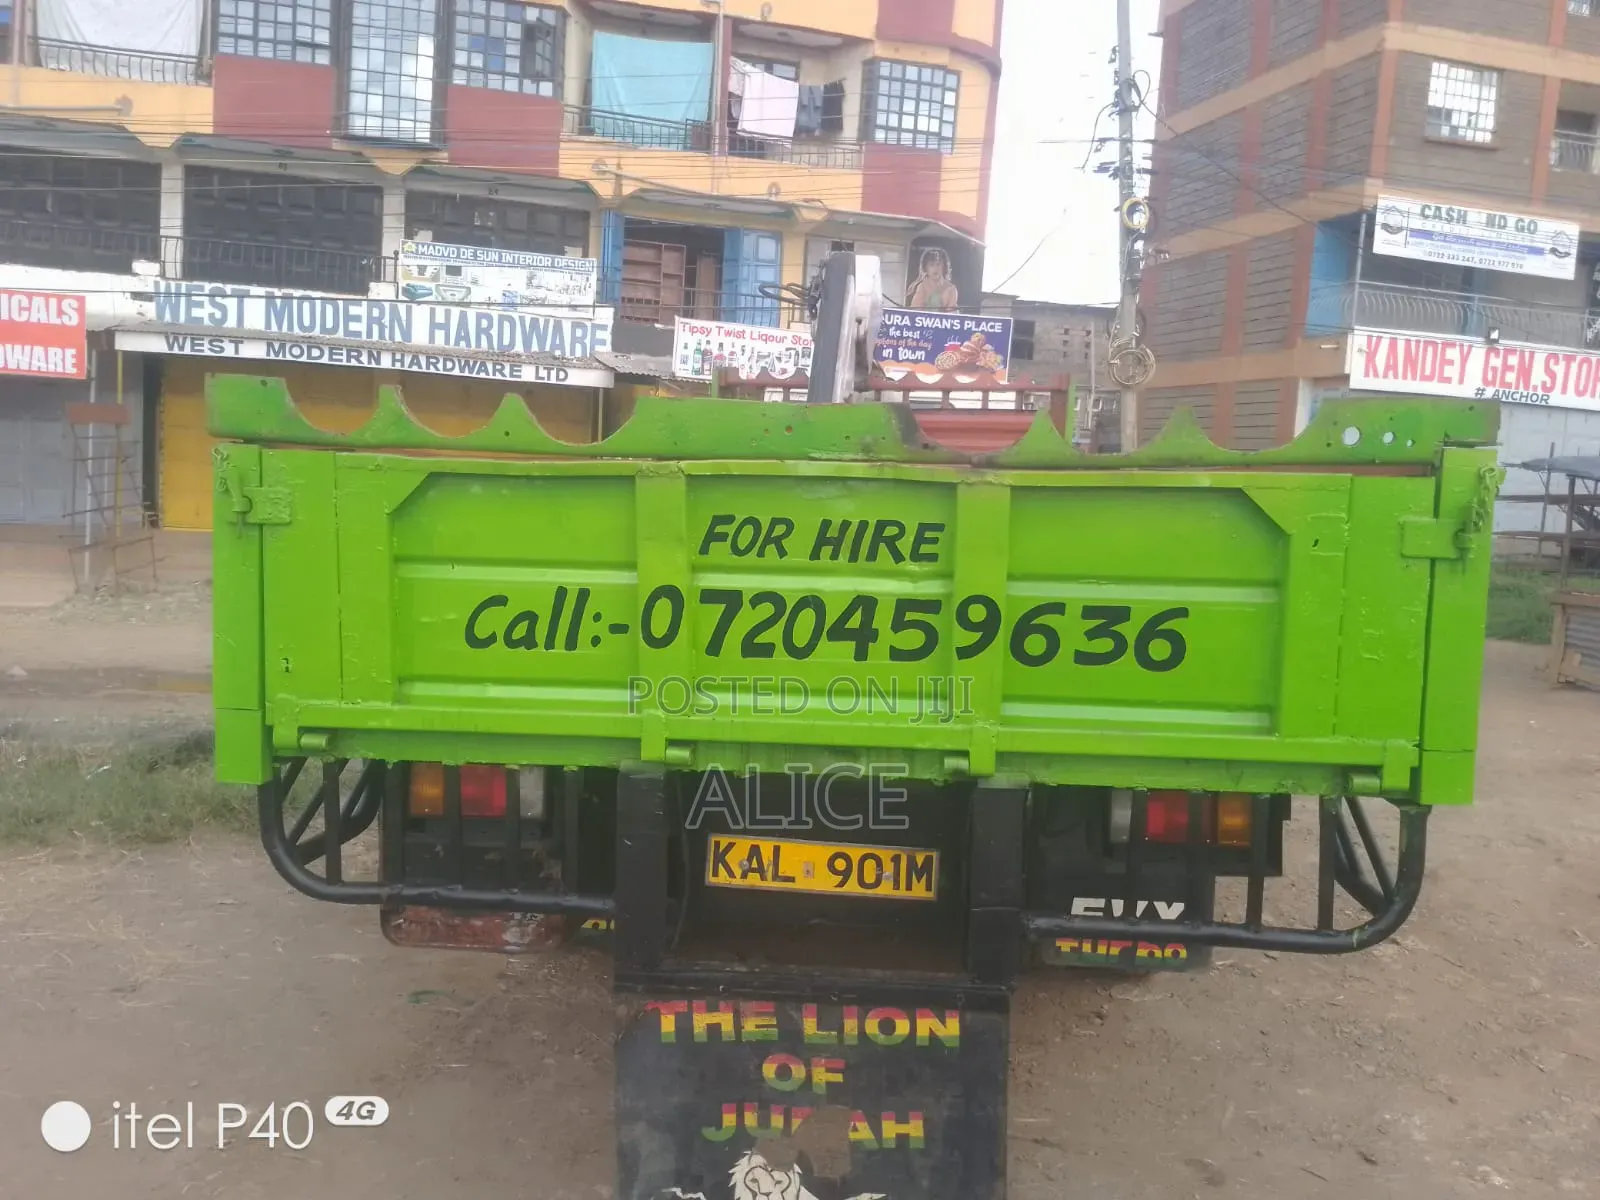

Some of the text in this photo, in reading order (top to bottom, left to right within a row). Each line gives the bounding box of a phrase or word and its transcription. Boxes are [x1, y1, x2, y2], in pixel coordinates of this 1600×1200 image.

[1420, 204, 1538, 235] CASH ND GO
[475, 250, 500, 263] SUN
[501, 252, 551, 268] INTERIOR
[555, 258, 593, 272] DESIGN
[153, 281, 609, 358] WEST MODERN HARDWARE
[680, 321, 712, 337] Tipsy
[715, 325, 746, 340] Twist
[750, 330, 787, 345] Liqour
[903, 327, 921, 340] best
[915, 316, 961, 330] SWAN'S
[964, 320, 1003, 333] PLACE
[164, 333, 568, 382] WEST MODERN HARDWARE LTD
[882, 345, 926, 361] in town
[1363, 334, 1473, 385] KANDEY
[1491, 388, 1551, 404] ANCHOR
[698, 514, 946, 565] FOR HIRE
[640, 584, 1190, 673] 0720459636
[711, 840, 935, 893] KAL 901M
[643, 1000, 961, 1048] THE LION
[762, 1053, 846, 1095] OF
[701, 1102, 926, 1149] JUAH
